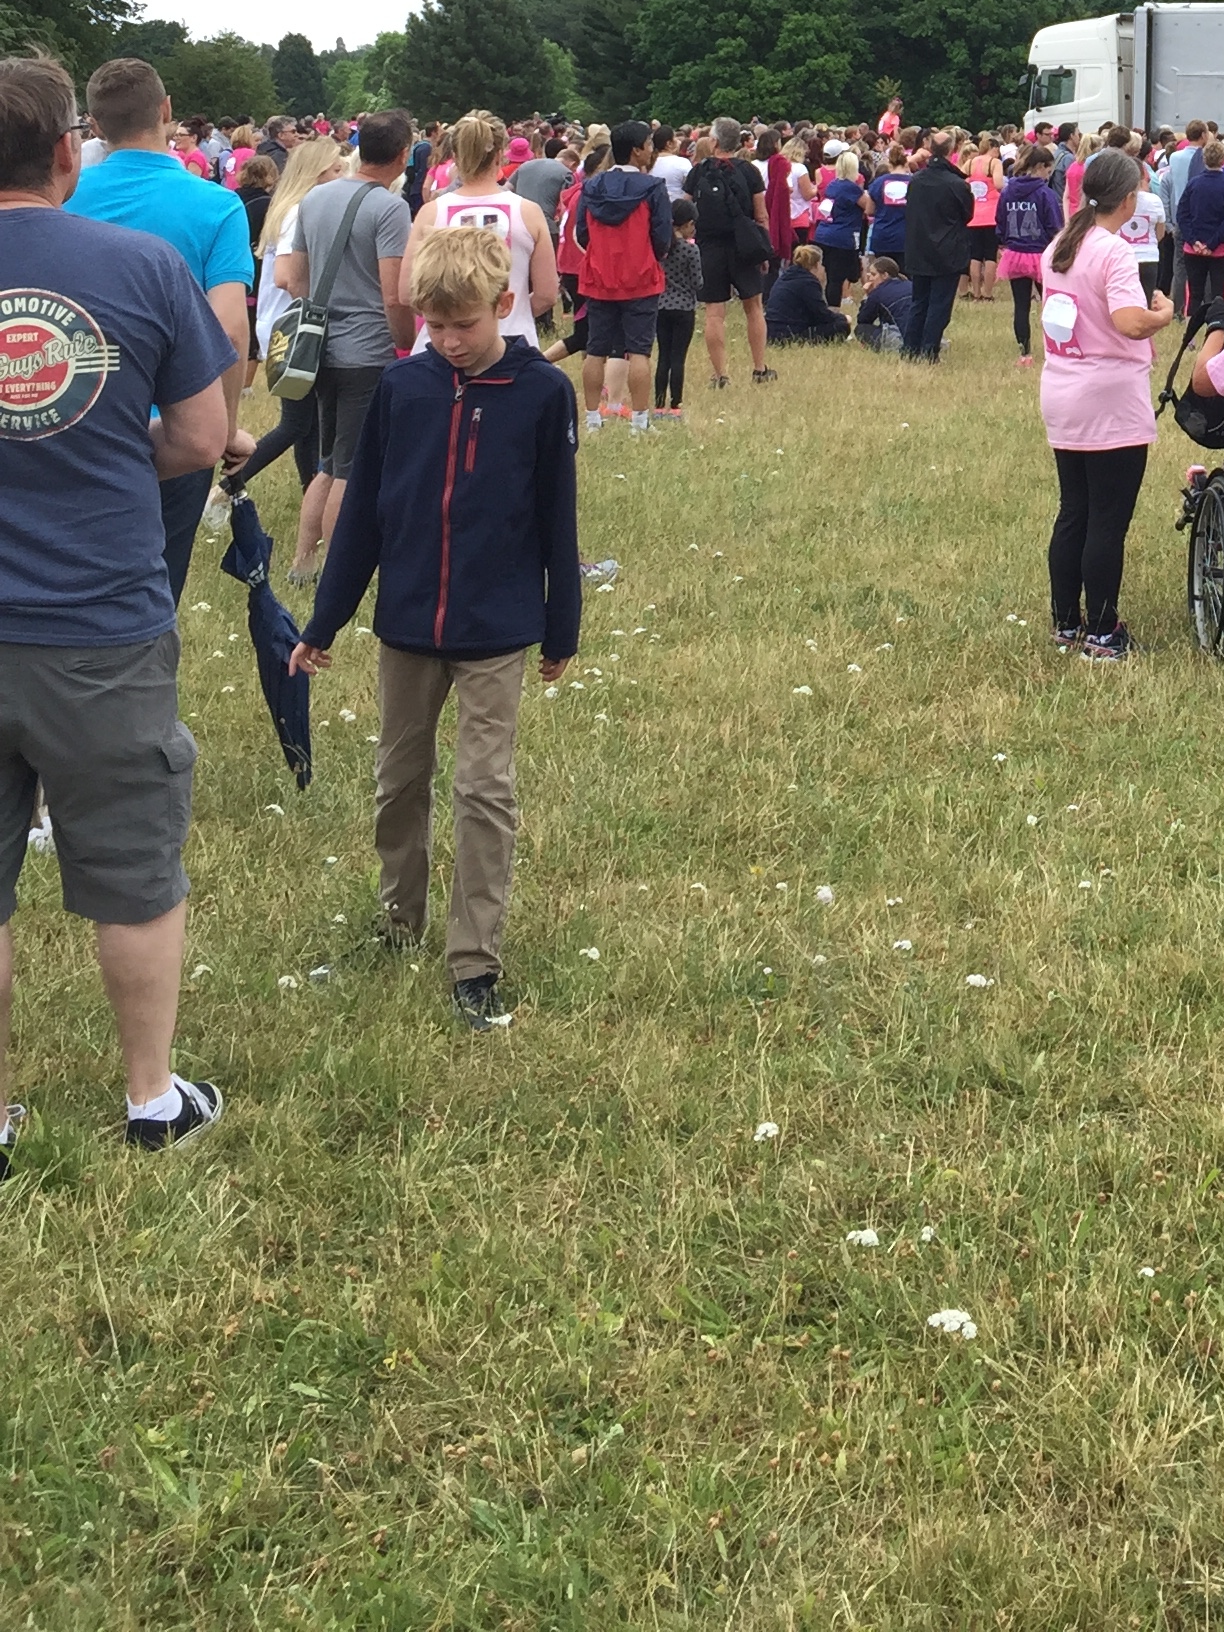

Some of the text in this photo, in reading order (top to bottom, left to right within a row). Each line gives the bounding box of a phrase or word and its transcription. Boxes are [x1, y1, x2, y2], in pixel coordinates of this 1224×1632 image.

[1006, 201, 1037, 212] LUCIA
[1007, 210, 1041, 240] 14
[1, 297, 76, 327] OMOTIVE
[6, 332, 39, 343] EXPERT
[43, 331, 96, 366] Rule
[5, 381, 57, 394] EVERYTHING
[0, 408, 61, 431] ERVICE
